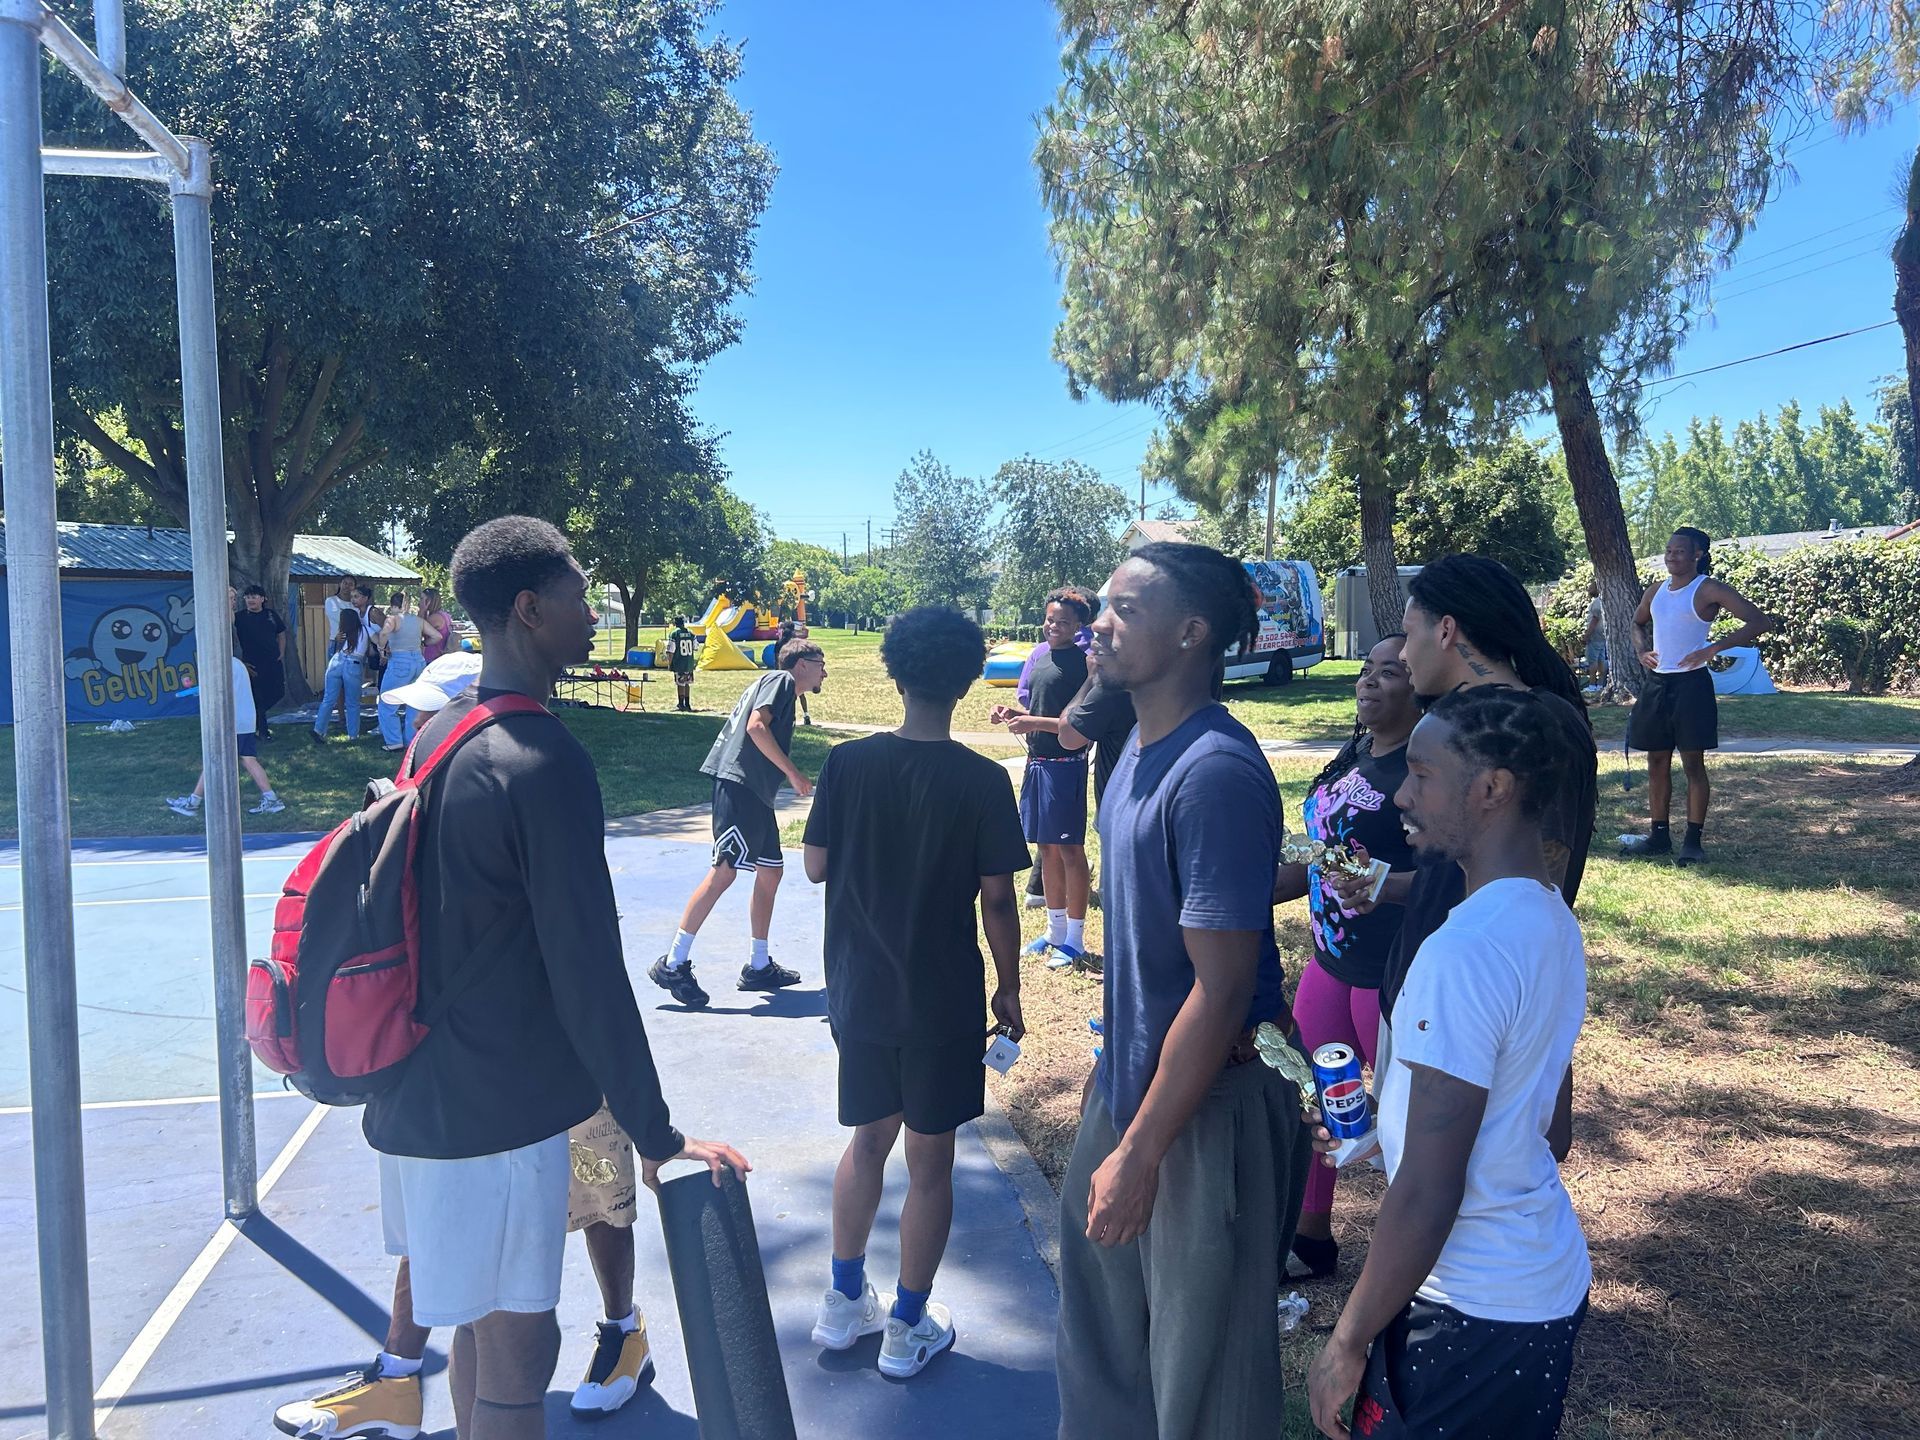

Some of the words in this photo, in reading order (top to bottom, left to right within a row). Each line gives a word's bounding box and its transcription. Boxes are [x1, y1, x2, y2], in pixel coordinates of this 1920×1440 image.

[680, 639, 692, 656] 80
[82, 651, 199, 707] Gellyba
[1331, 767, 1386, 811] ANGEL
